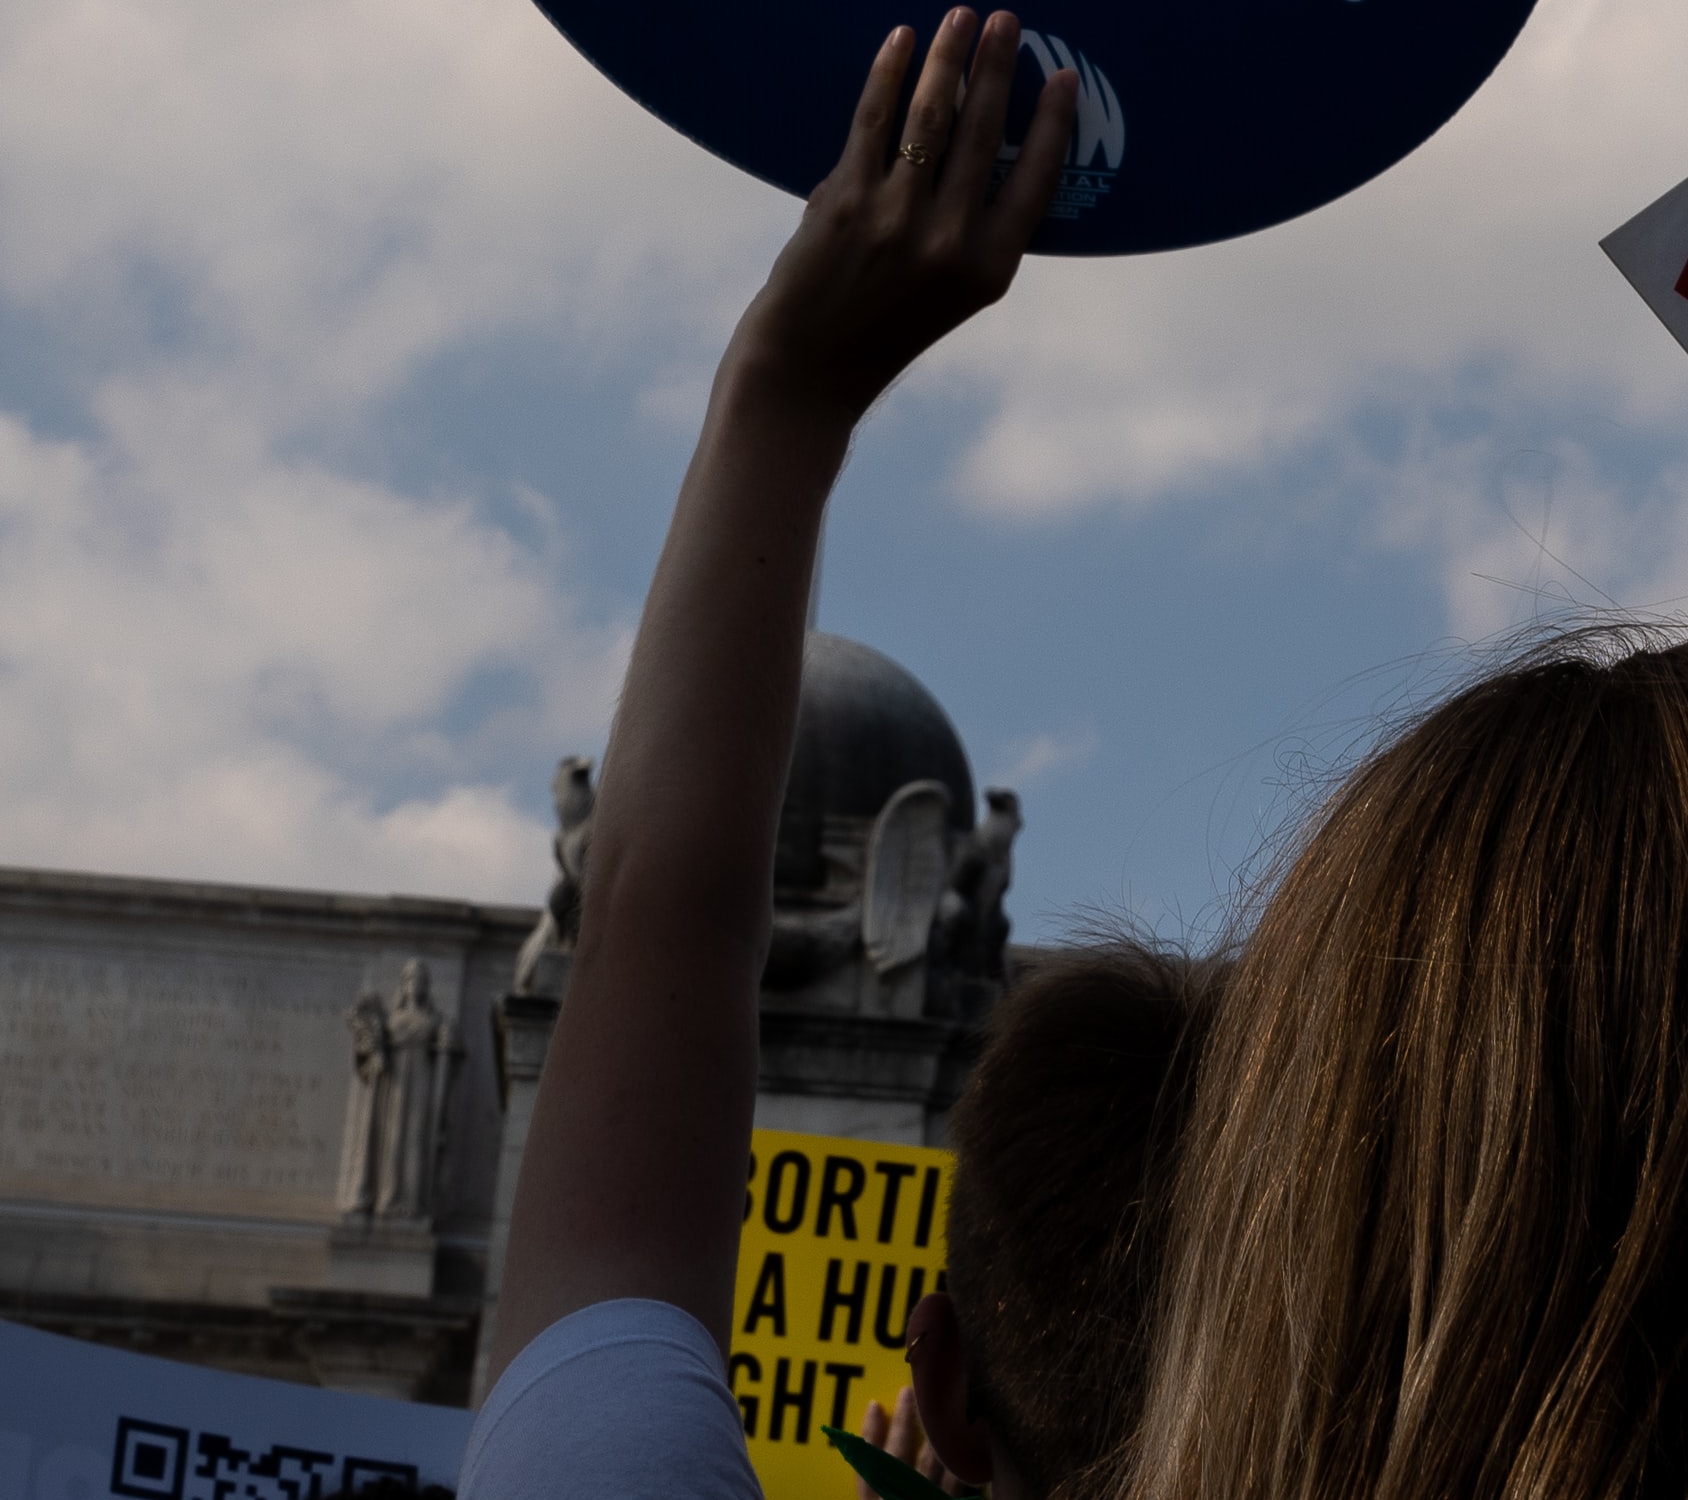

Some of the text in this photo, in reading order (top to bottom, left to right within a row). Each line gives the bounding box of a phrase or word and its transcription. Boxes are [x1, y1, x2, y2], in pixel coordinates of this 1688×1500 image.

[742, 1150, 940, 1248] ORTI
[744, 1253, 948, 1350] A HU
